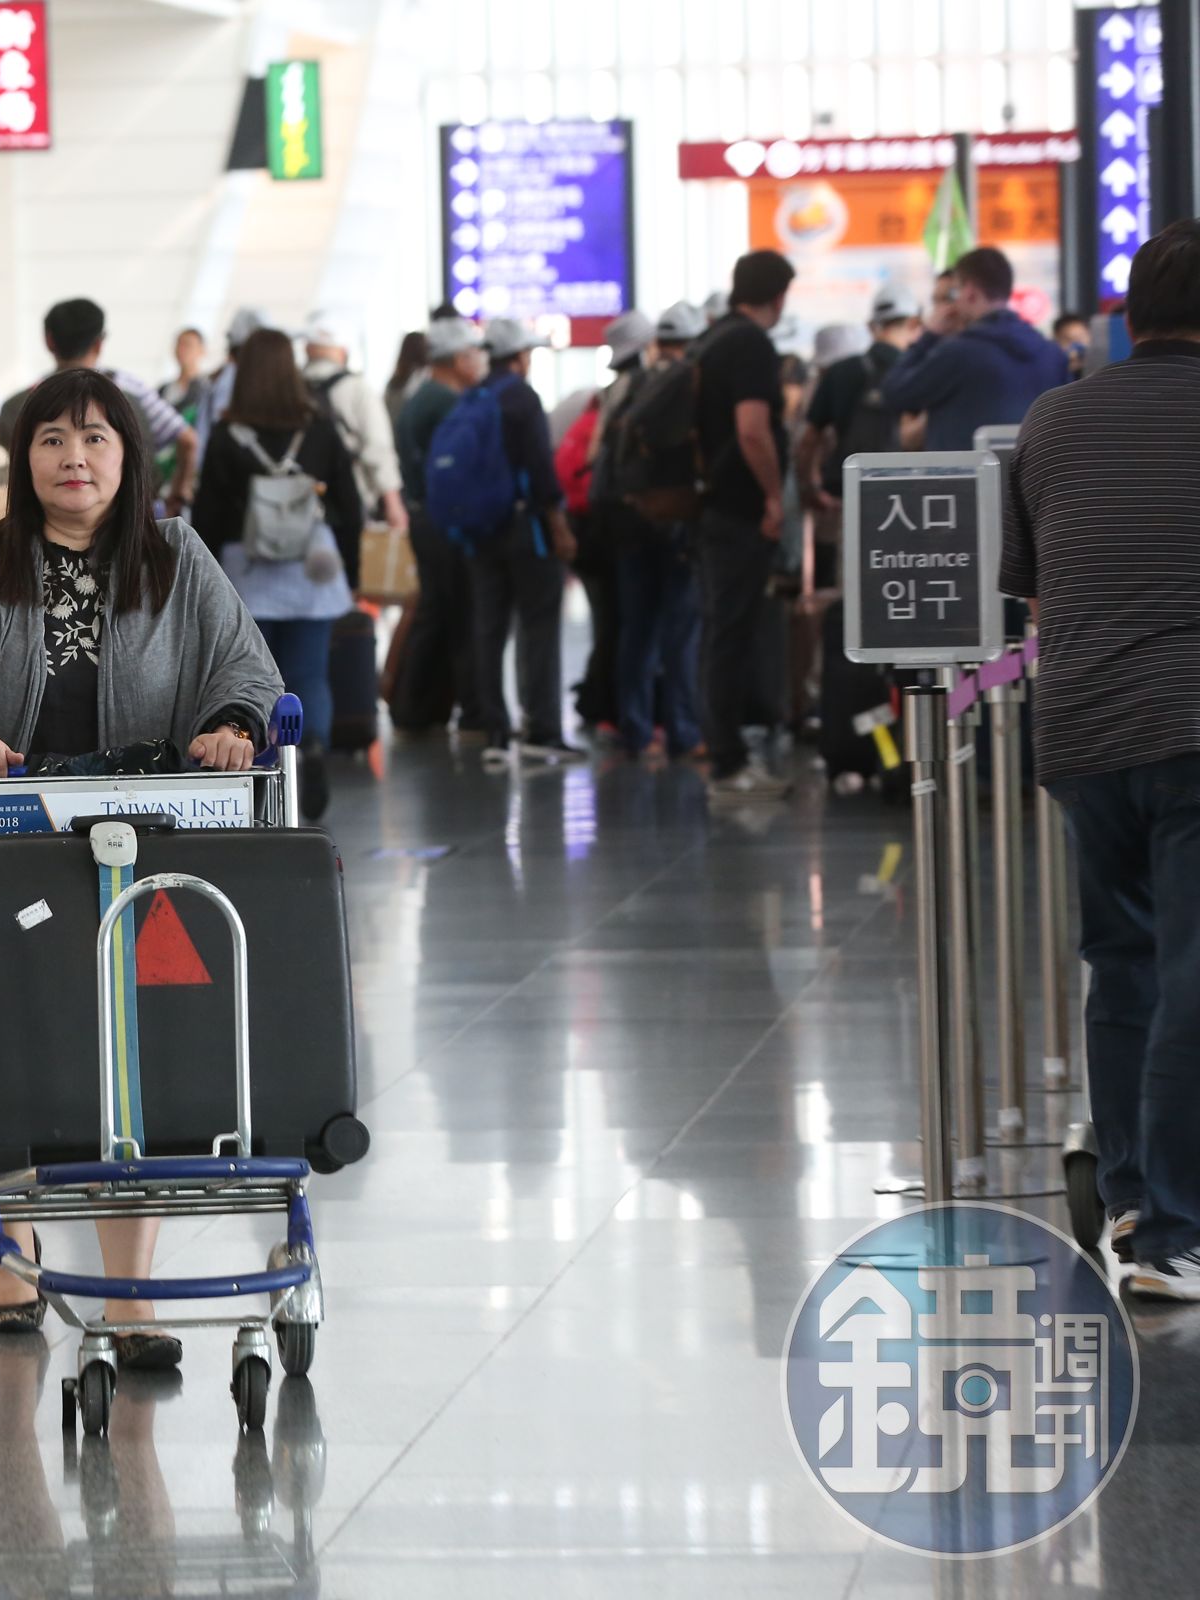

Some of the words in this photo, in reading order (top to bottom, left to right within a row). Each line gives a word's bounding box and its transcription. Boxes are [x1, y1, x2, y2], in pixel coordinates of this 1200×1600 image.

[877, 494, 957, 532] 入口
[869, 549, 971, 569] Entrance
[881, 579, 962, 621] 입구
